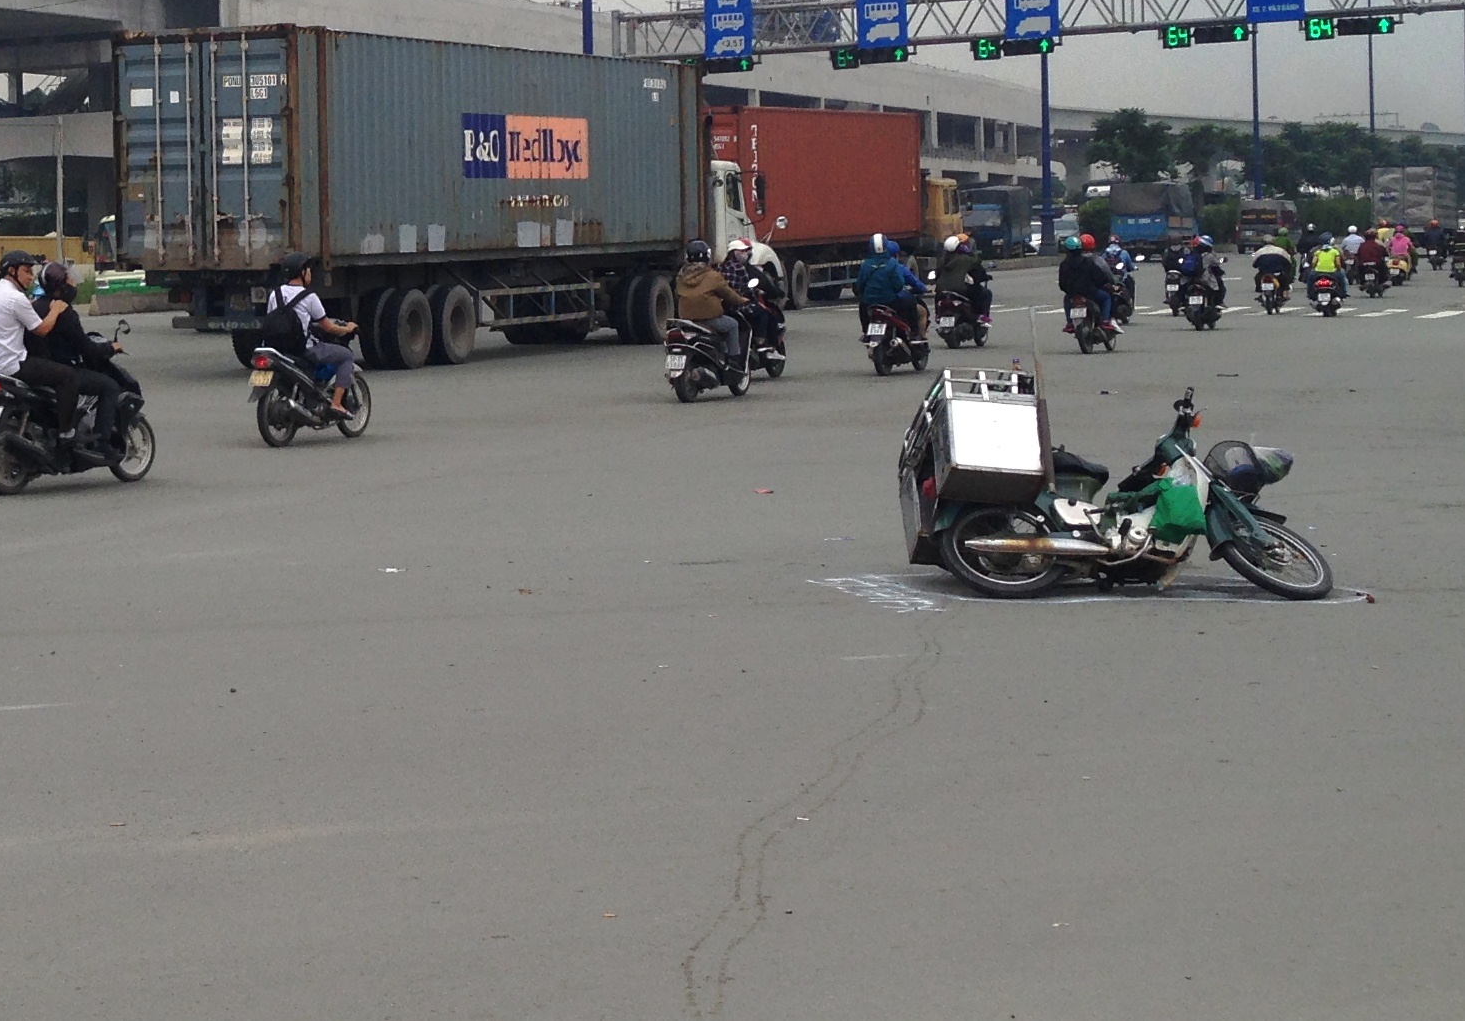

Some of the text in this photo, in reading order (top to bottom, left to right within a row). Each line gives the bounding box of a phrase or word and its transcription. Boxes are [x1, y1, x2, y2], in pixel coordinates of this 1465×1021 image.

[1168, 26, 1188, 46] 64
[1308, 18, 1332, 39] 64
[463, 128, 582, 172] P&O Nedlloyd
